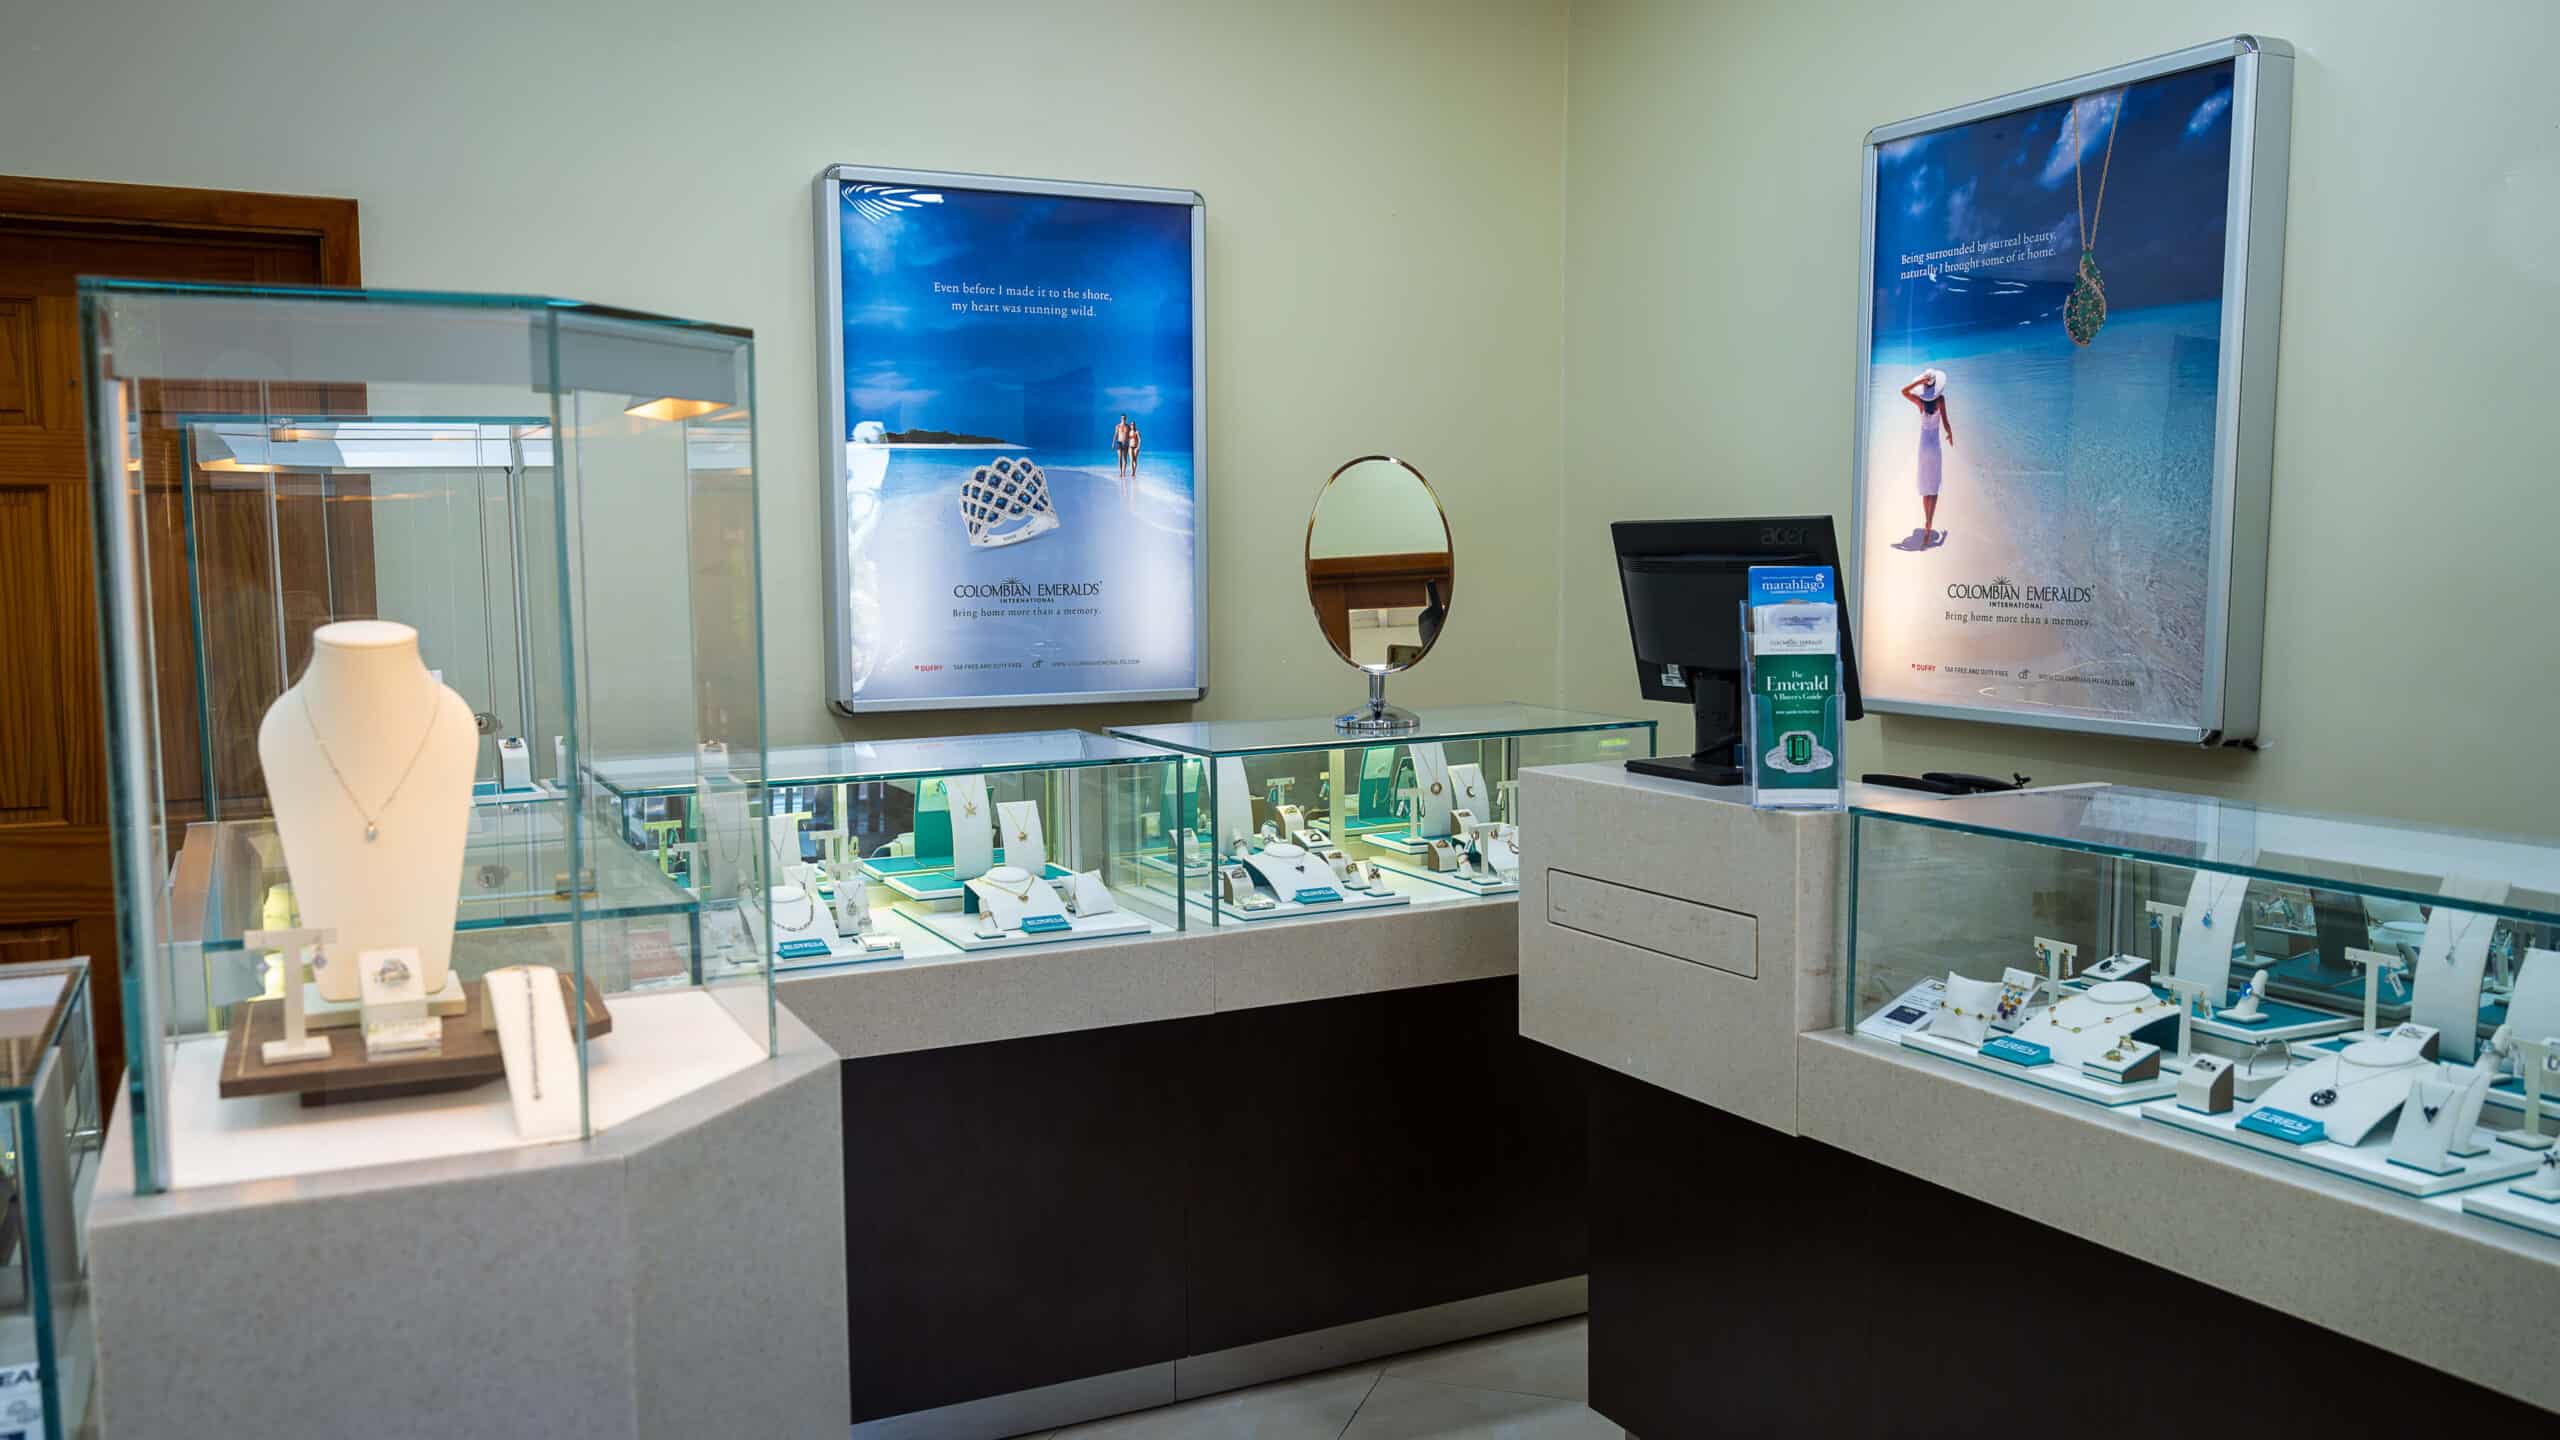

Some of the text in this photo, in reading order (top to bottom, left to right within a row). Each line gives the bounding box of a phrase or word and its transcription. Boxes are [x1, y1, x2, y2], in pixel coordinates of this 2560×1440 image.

[1901, 252, 1925, 265] Being
[1926, 241, 1975, 261] surrounded
[1978, 240, 1987, 255] by
[1989, 232, 2021, 249] surreal
[1901, 263, 1937, 280] naturally
[1945, 256, 1981, 273] brought
[1982, 255, 2004, 267] some
[2006, 250, 2016, 264] of
[2017, 250, 2025, 261] it
[2027, 247, 2057, 261] home.
[933, 281, 960, 293] Even
[962, 281, 996, 294] before
[1006, 284, 1034, 297] made
[1037, 286, 1047, 297] it
[1048, 287, 1060, 298] to
[1062, 288, 1080, 299] the
[1082, 288, 1113, 303] shore,
[952, 300, 1097, 318] my heart was running wild.
[1760, 527, 1809, 545] acer
[953, 583, 1100, 598] COLOMBIAN EMERALDS
[1762, 580, 1825, 593] marahlago
[1947, 584, 2091, 603] COLOMBIAN EMERALDS
[953, 607, 978, 619] Bring
[981, 607, 1004, 617] home
[1008, 608, 1029, 617] more
[1033, 606, 1054, 616] than
[1063, 607, 1102, 617] memory.
[1989, 601, 2043, 609] INTERNATIONAL
[1945, 611, 1968, 624] Bring
[1970, 612, 1993, 623] home
[1996, 615, 2018, 624] more
[2020, 613, 2041, 625] than
[2052, 617, 2092, 629] memory.
[1767, 675, 1829, 691] Emerald
